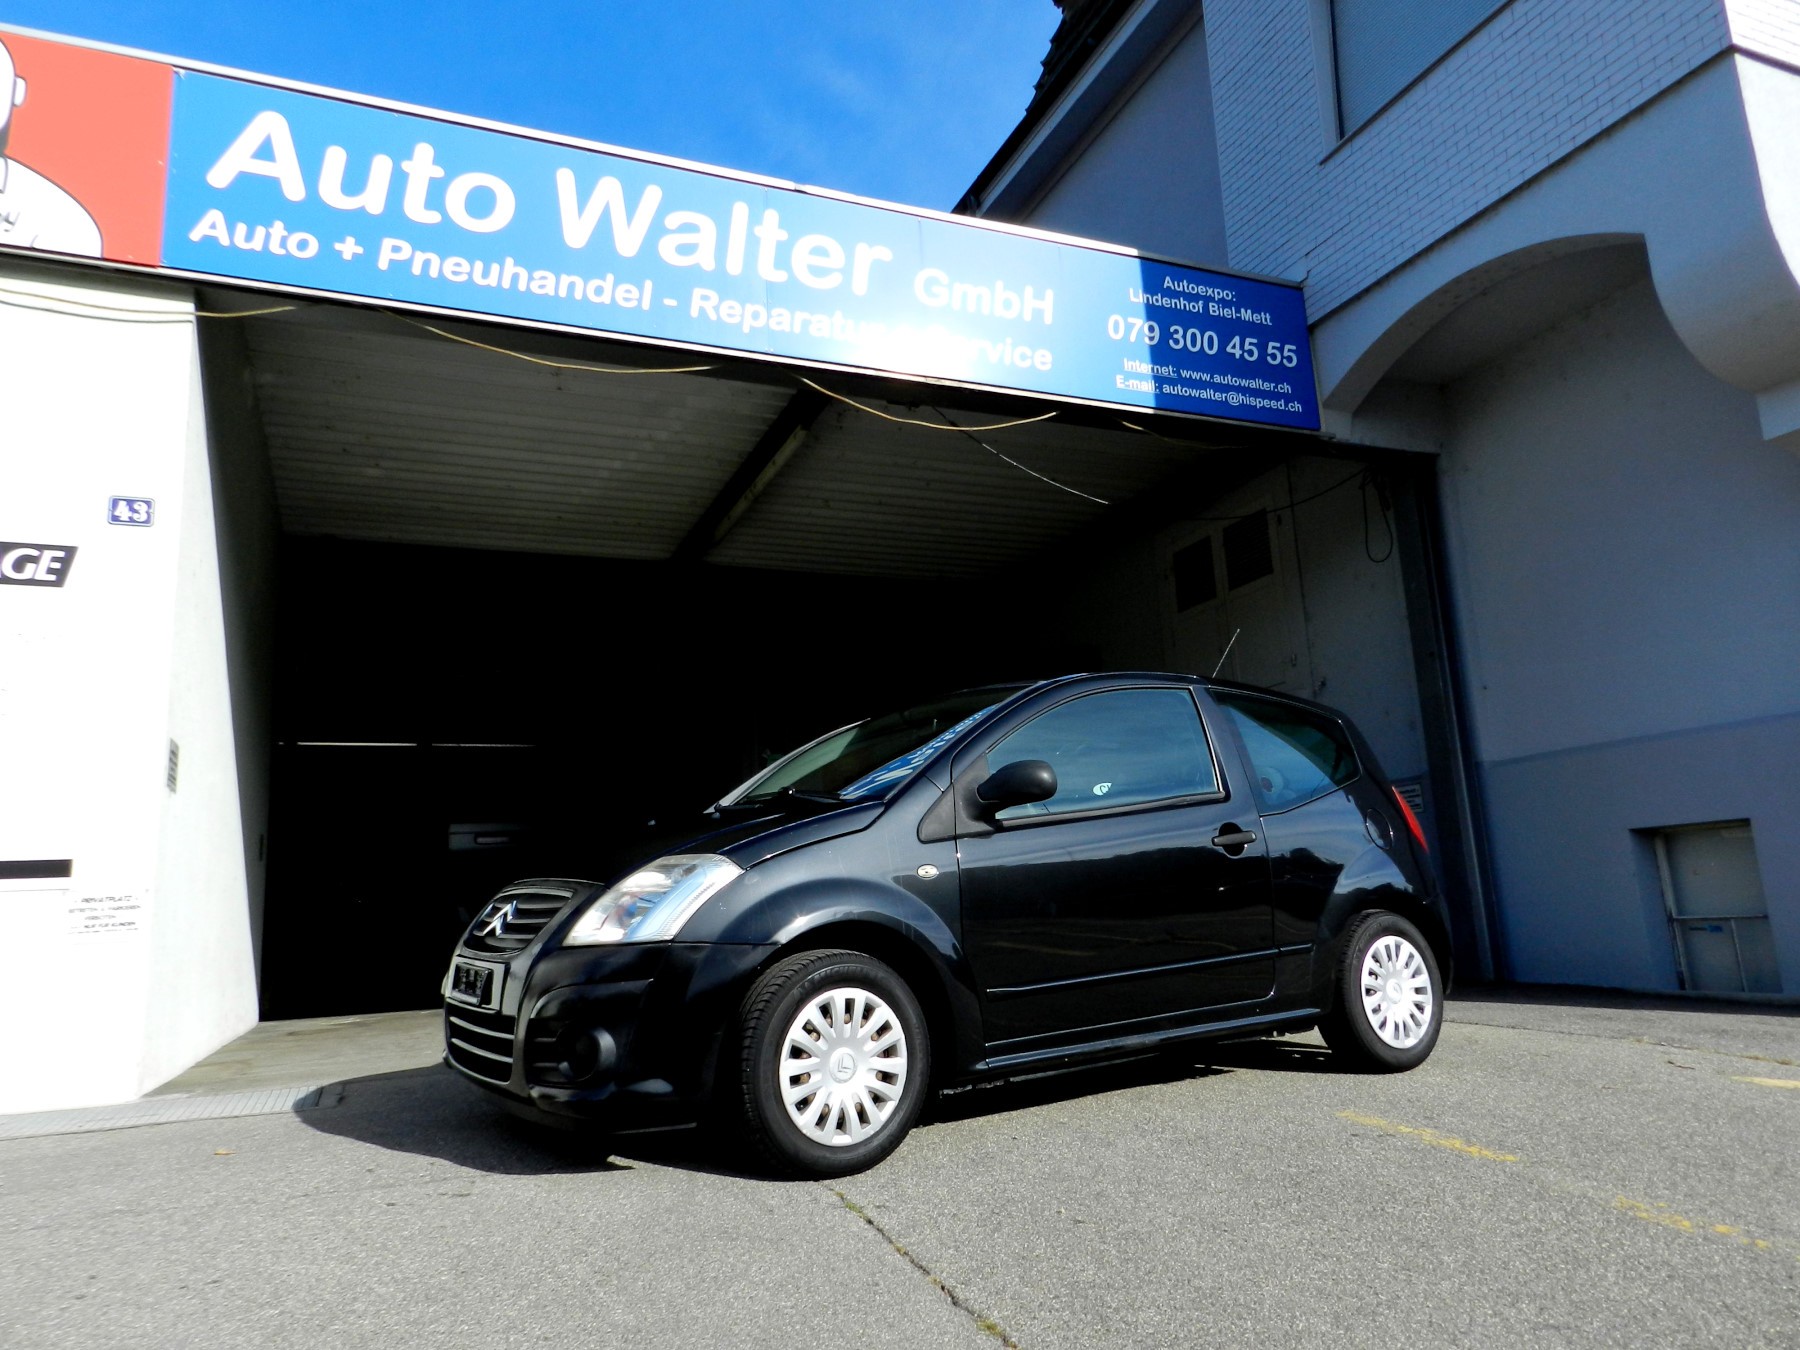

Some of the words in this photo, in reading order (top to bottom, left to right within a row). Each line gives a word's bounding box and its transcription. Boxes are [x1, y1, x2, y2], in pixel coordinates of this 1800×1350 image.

[206, 110, 516, 233] Auto
[556, 167, 893, 296] Walter
[914, 267, 1054, 325] GmbH
[188, 208, 319, 259] Auto
[334, 236, 364, 260] +
[377, 238, 653, 311] Pneuhandel
[1129, 287, 1204, 314] Lindenhof
[1208, 302, 1273, 326] Biel-Mett
[1163, 276, 1236, 301] Autoexpo:
[1107, 314, 1160, 346] 079
[1168, 325, 1219, 355] 300
[1226, 335, 1259, 362] 45
[1266, 341, 1298, 368] 55
[1115, 374, 1160, 393] E-mail:
[1162, 383, 1302, 412] autowalter@hispeed.ch
[1123, 357, 1178, 379] Internet:
[1180, 368, 1292, 394] www.autowalter.ch
[114, 500, 149, 523] 43
[0, 547, 66, 581] GE
